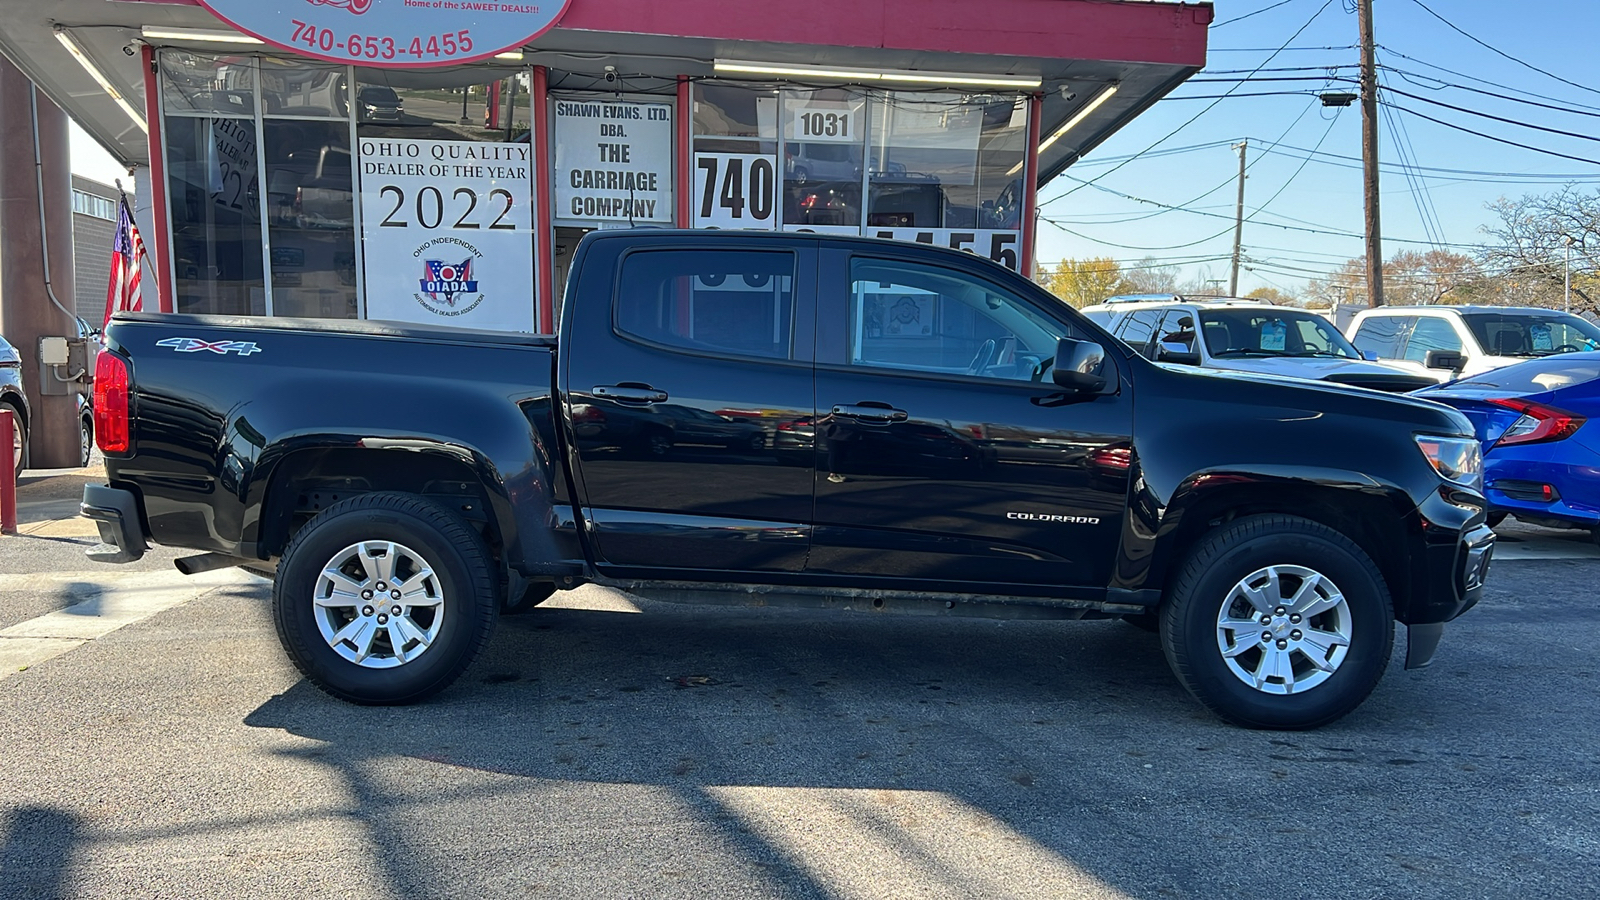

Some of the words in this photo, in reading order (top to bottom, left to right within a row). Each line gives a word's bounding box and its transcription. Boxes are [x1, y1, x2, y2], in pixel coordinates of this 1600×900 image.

[404, 0, 431, 8] Home
[432, 1, 443, 9] of
[444, 1, 459, 10] the
[461, 2, 499, 12] SAWEET
[501, 4, 540, 14] DEALS!!!
[290, 19, 473, 60] 740-653-4455
[557, 102, 600, 118] SHAWN
[603, 105, 643, 120] EVANS.
[647, 107, 670, 121] LTD.
[600, 123, 627, 138] DBA.
[800, 112, 848, 137] 1031
[361, 142, 420, 158] OHIO
[431, 144, 529, 161] QUALITY
[597, 143, 630, 163] THE
[364, 162, 426, 176] DEALER
[429, 164, 449, 177] OF
[452, 165, 484, 178] THE
[487, 166, 527, 179] YEAR
[570, 168, 658, 192] CARRIAGE
[698, 157, 773, 220] 740
[379, 185, 516, 230] 2022
[571, 196, 657, 218] COMPANY
[413, 241, 431, 258] OHIO
[431, 237, 484, 259] INDEPENDENT
[427, 281, 469, 292] OIADA
[413, 293, 439, 315] AUTOMOBILE
[460, 293, 485, 315] ASSOCIATION
[1006, 512, 1100, 525] COLORADO
